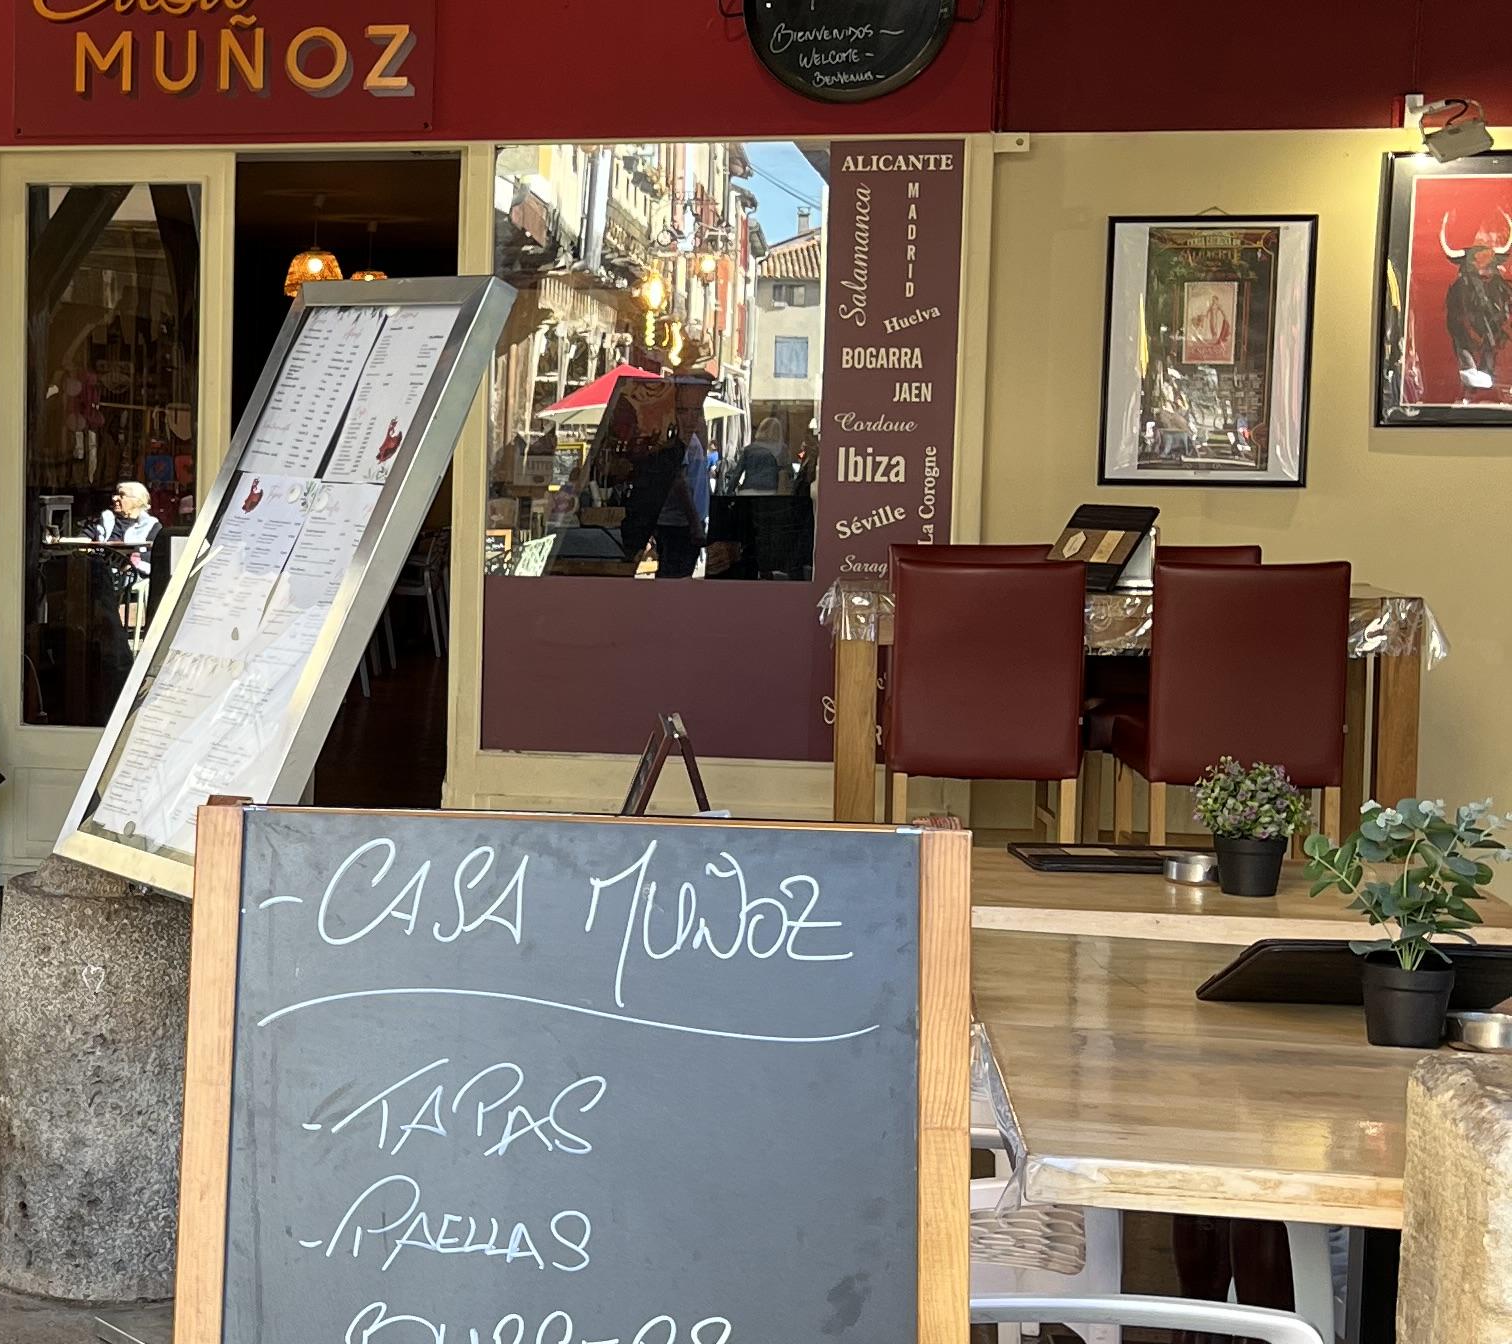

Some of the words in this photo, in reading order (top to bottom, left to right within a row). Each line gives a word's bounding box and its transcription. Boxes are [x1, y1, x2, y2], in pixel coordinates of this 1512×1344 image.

[74, 14, 411, 93] MUÑOZ
[798, 50, 861, 68] WELCOME
[841, 154, 953, 172] ALICANTE
[838, 182, 871, 327] Salamanca
[905, 181, 920, 298] MADRID
[882, 306, 941, 334] Huelva
[841, 346, 923, 369] BOGARRA
[892, 382, 932, 402] JAEN
[834, 411, 918, 432] Cordoue
[837, 446, 906, 483] Ibiza
[918, 446, 939, 520] Corogne
[835, 505, 907, 539] Séville
[840, 554, 888, 578] Sarag
[316, 837, 529, 945] CASA
[584, 839, 853, 1008] MUÑOZ
[330, 1057, 607, 1156] TAPAS
[326, 1174, 593, 1271] PAELLAS
